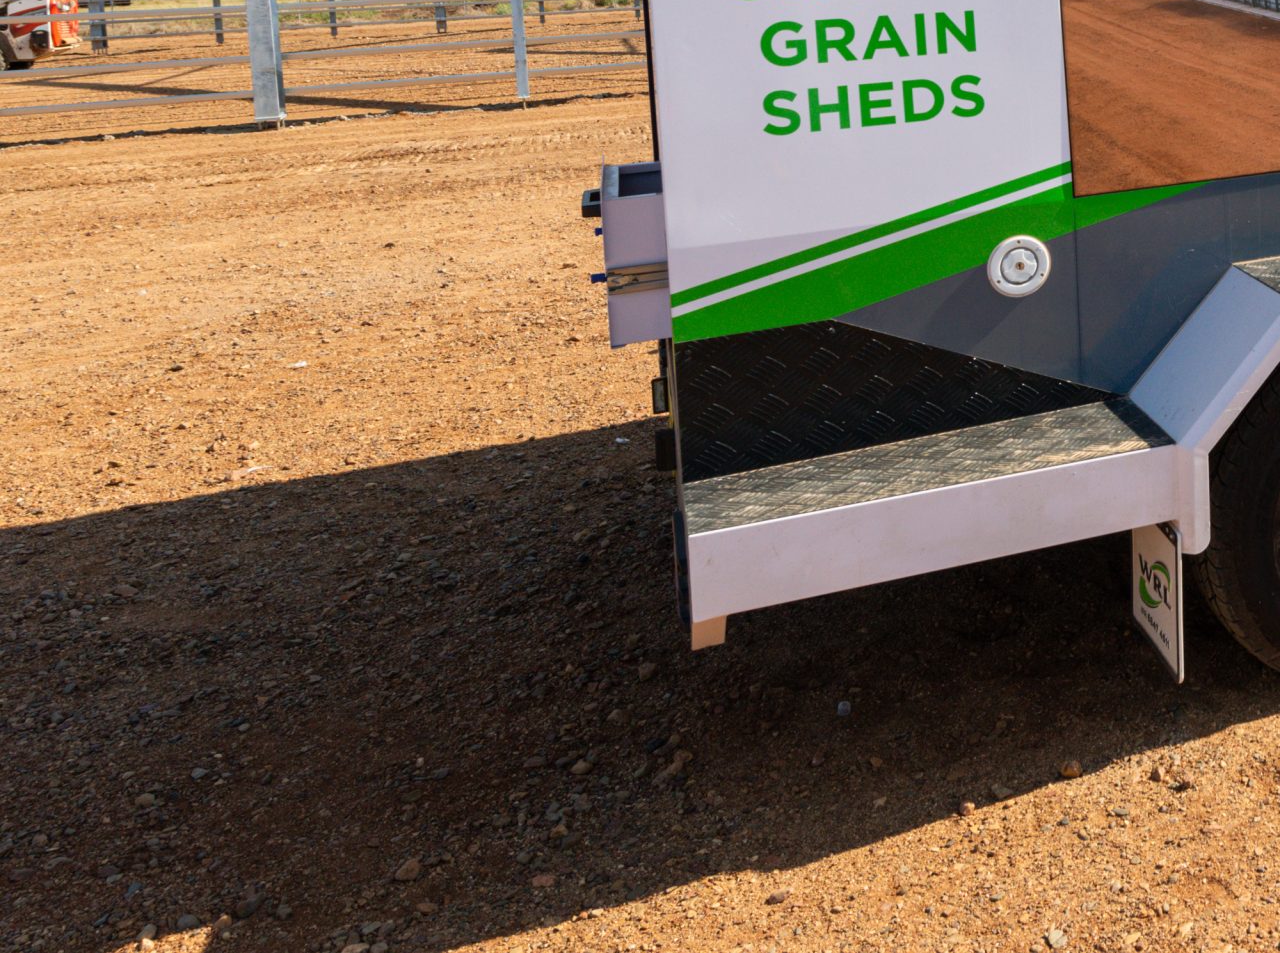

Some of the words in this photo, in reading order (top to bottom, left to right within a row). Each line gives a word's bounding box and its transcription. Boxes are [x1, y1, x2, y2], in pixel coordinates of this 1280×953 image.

[760, 10, 977, 67] GRAIN
[762, 74, 986, 136] SHEDS
[1138, 552, 1172, 611] WRL
